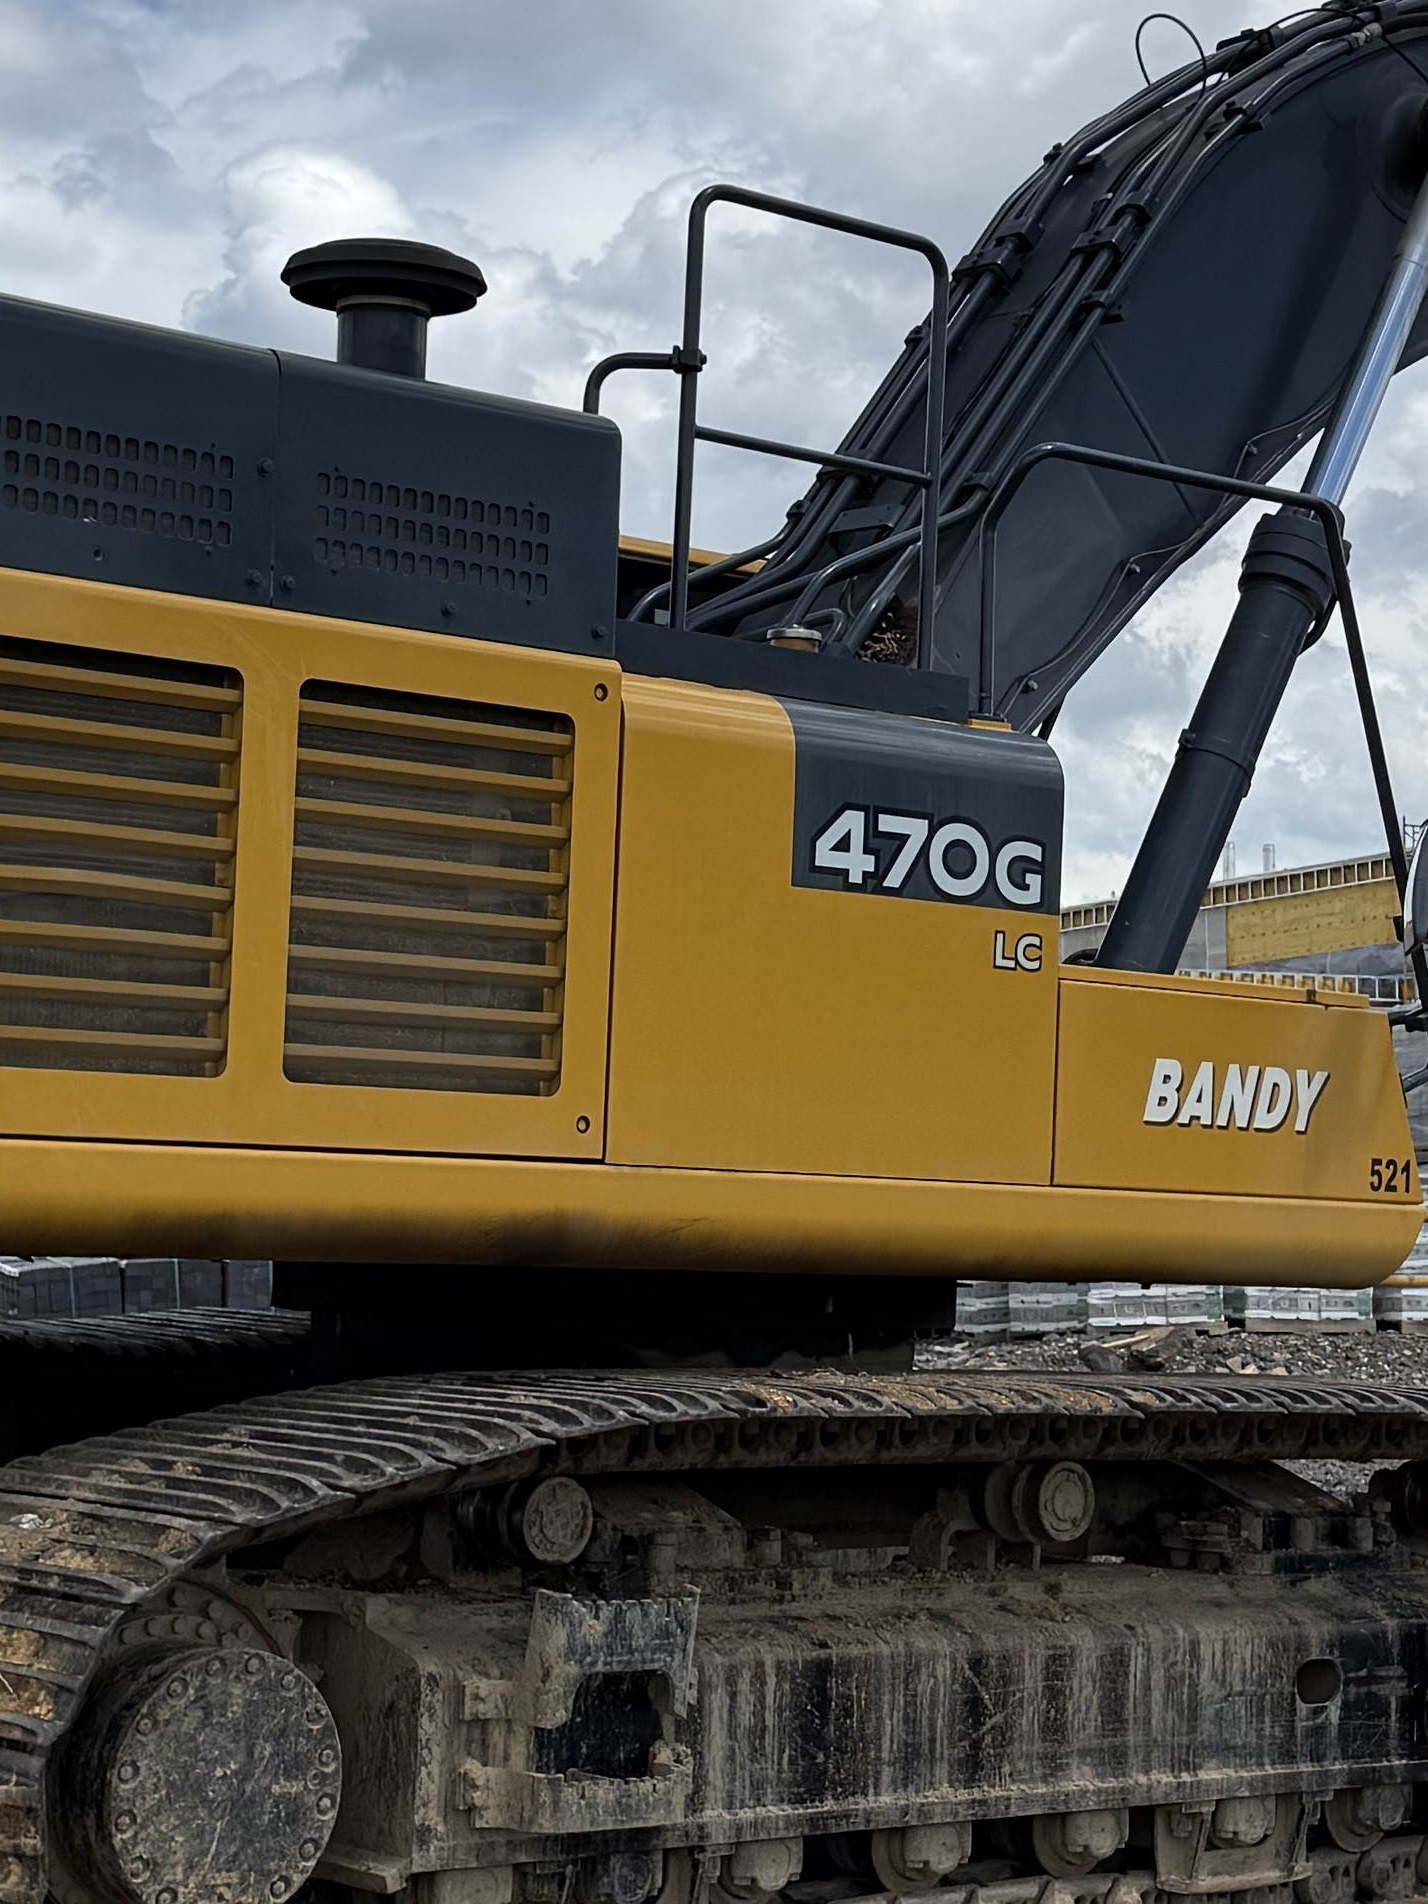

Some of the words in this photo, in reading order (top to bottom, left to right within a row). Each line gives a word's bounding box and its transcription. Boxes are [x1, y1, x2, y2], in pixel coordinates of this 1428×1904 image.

[814, 810, 1044, 904] 470G
[993, 930, 1043, 972] LC
[1143, 1057, 1330, 1134] BANDY
[1369, 1158, 1410, 1194] 521
